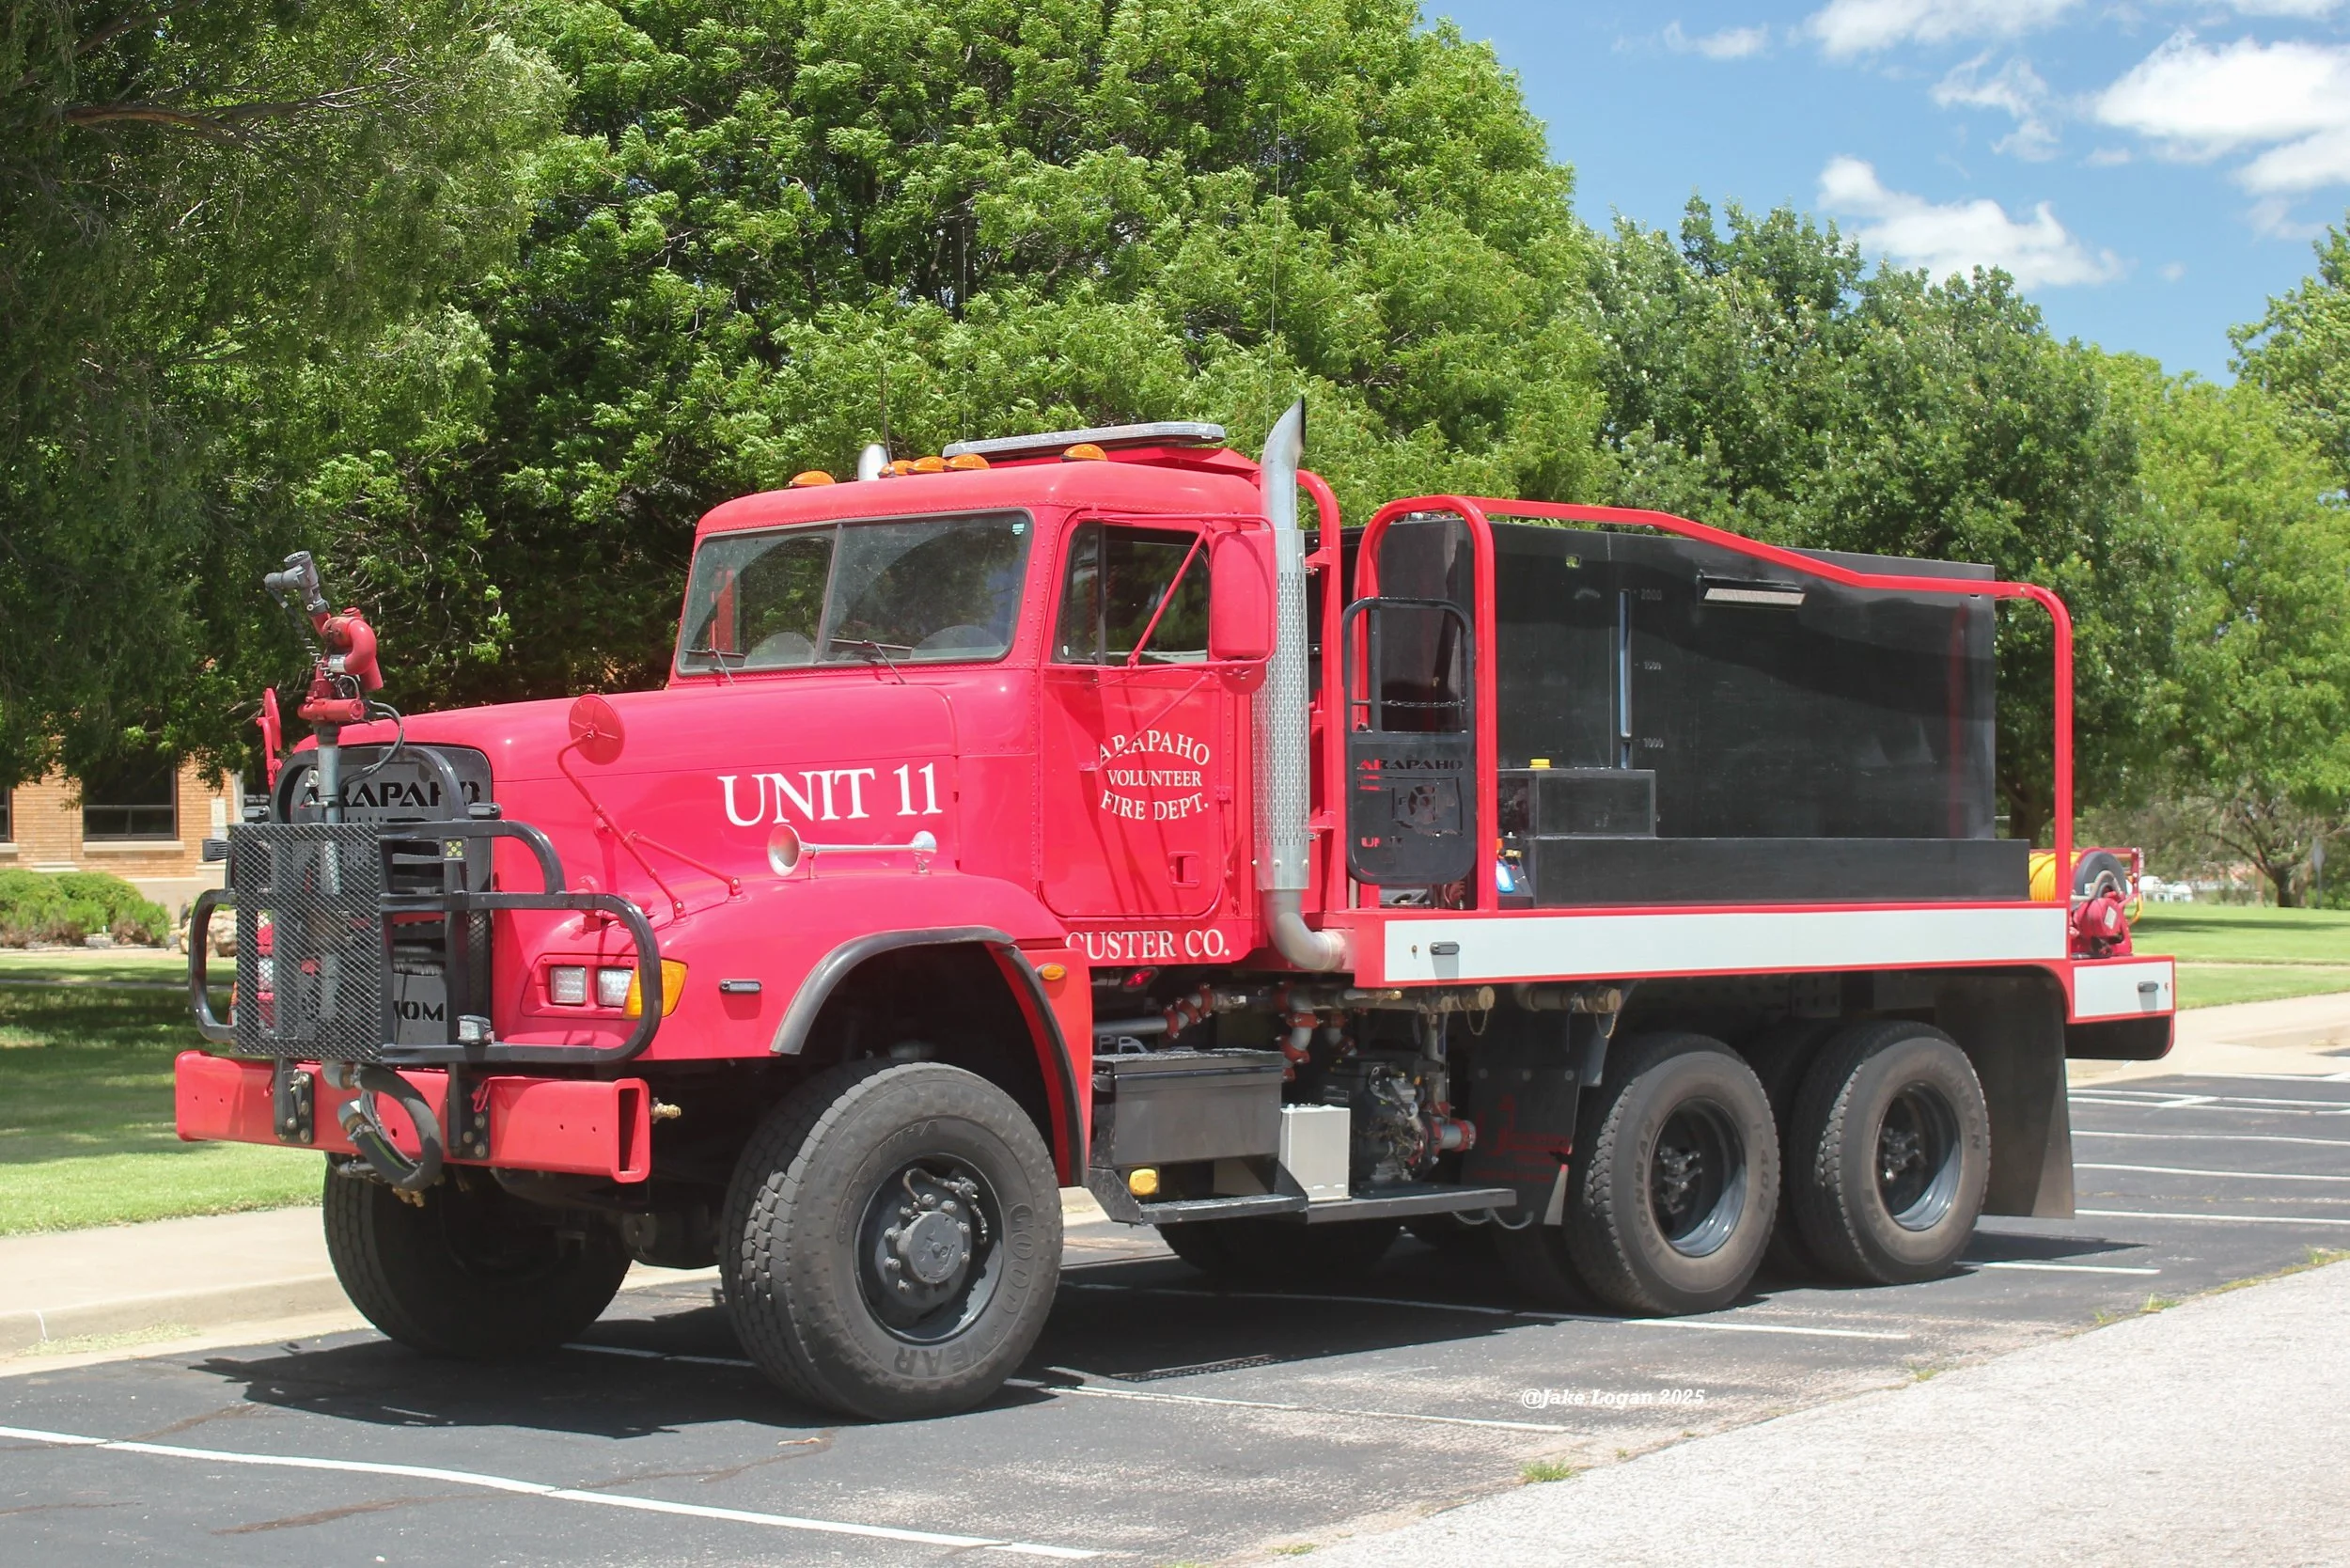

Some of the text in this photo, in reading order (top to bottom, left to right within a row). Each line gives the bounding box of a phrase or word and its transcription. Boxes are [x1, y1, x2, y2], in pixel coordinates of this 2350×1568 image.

[1640, 588, 1663, 601] 2000
[1099, 729, 1210, 766] ARAPAHO
[1643, 738, 1664, 748] 1000
[1356, 759, 1464, 770] ARAPAHO
[1106, 770, 1202, 786] VOLUNTEER
[717, 762, 943, 826] UNIT 11
[1100, 790, 1209, 820] FIRE DEPT.
[1065, 929, 1230, 960] CUSTER CO.
